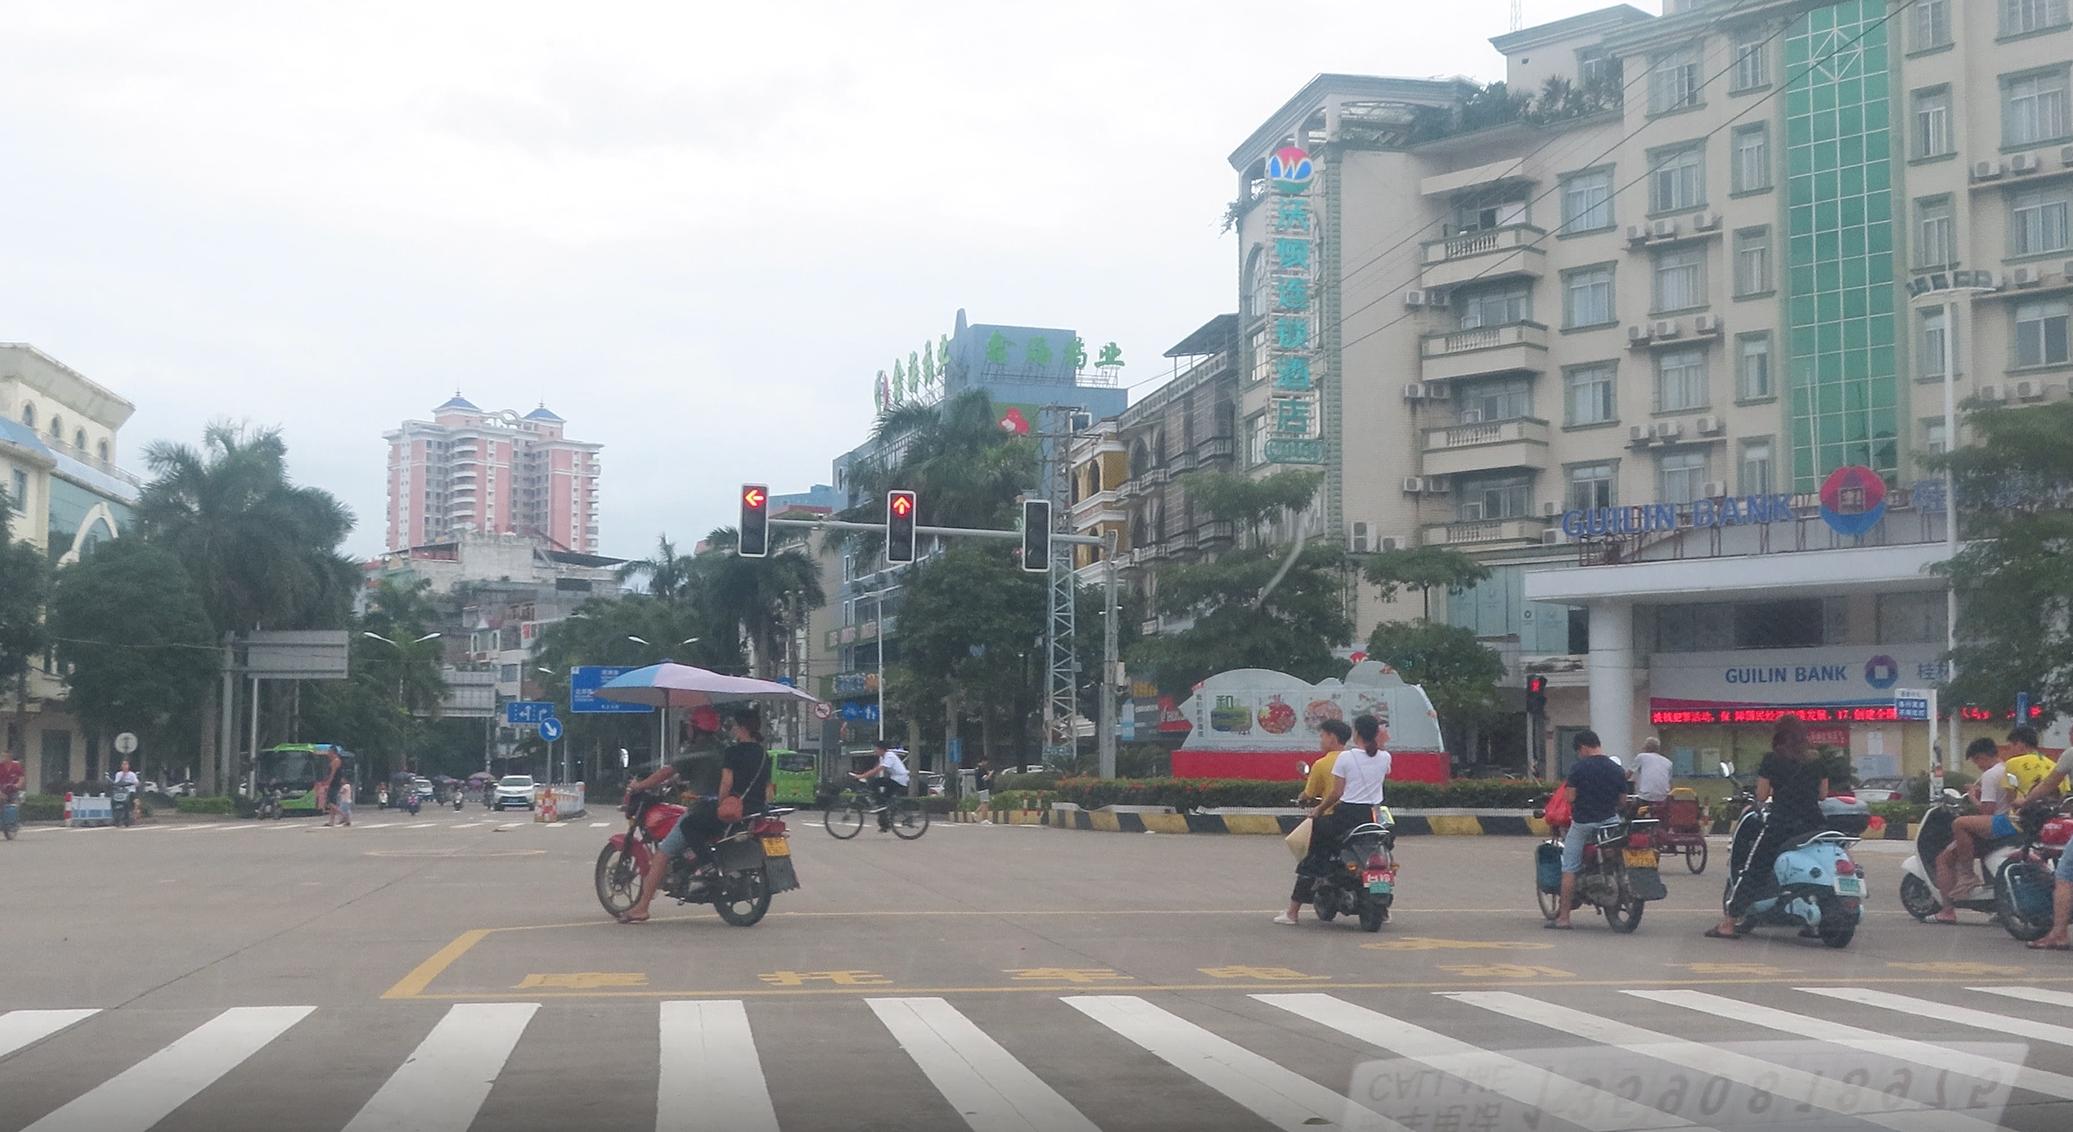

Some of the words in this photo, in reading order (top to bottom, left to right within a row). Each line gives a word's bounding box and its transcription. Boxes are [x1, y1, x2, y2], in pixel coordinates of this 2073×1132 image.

[1562, 502, 1677, 537] GUILIN
[1693, 494, 1794, 528] BANK
[1725, 666, 1787, 684] GUILIN
[1795, 664, 1847, 682] BANK
